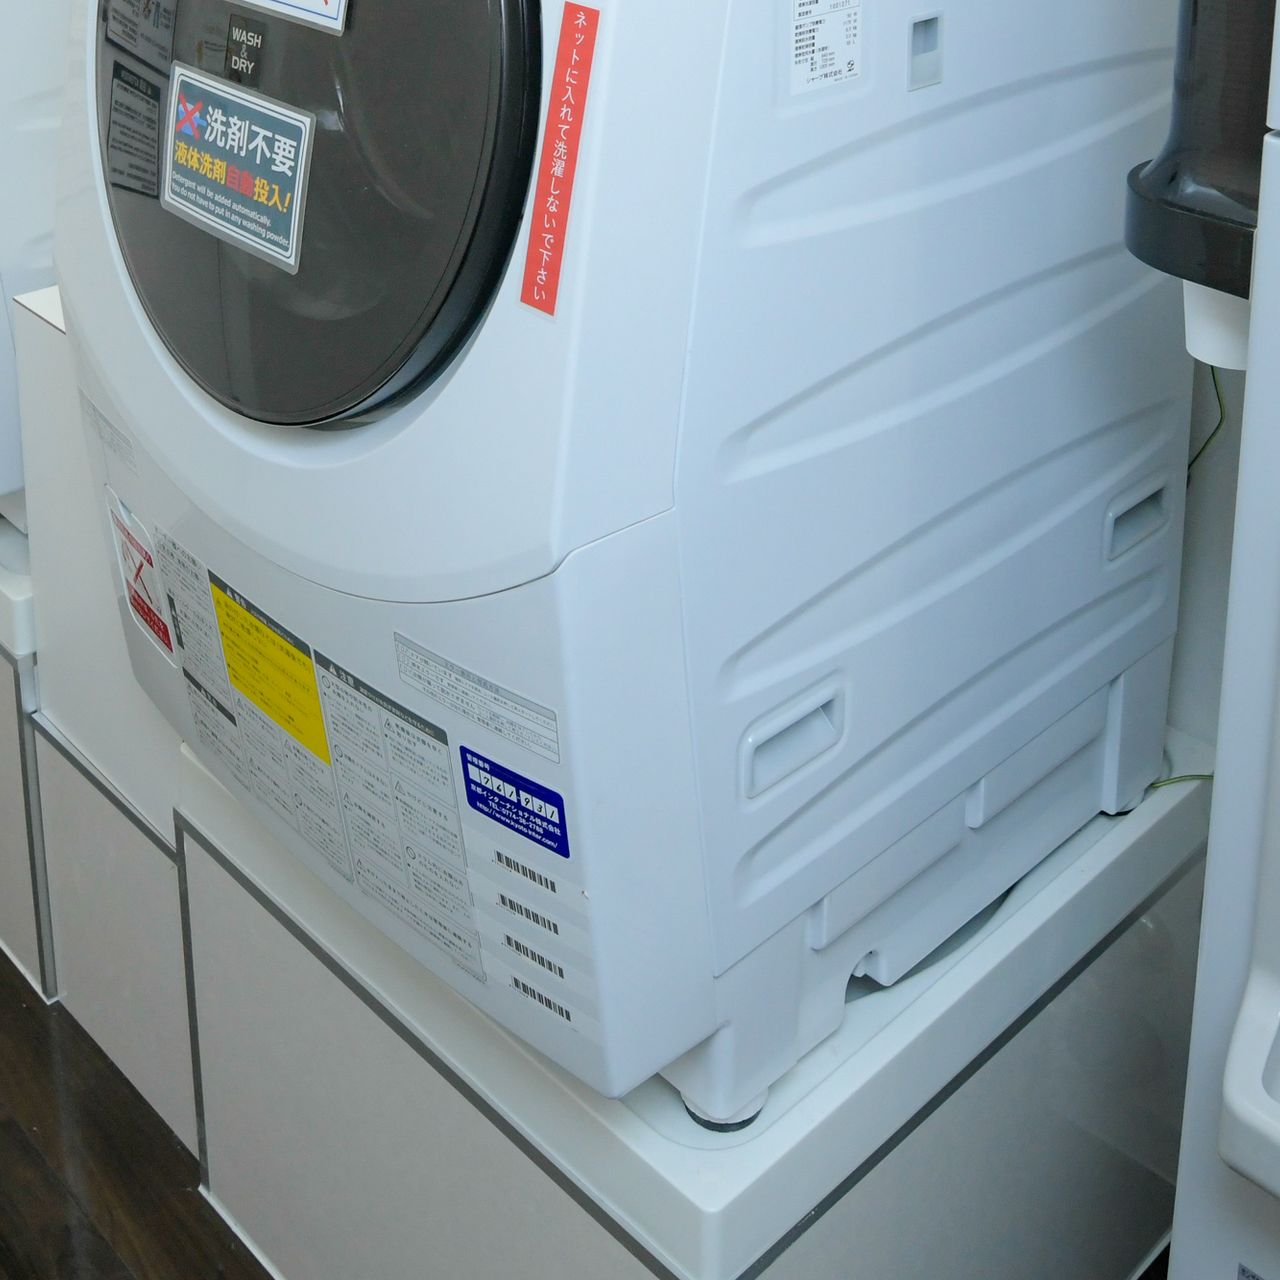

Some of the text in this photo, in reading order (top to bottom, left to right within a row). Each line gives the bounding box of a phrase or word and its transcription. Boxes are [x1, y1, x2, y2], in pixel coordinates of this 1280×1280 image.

[232, 56, 255, 74] DRY
[233, 27, 262, 48] WASH
[240, 45, 248, 58] &
[204, 104, 297, 177] 洗剤不要
[534, 11, 587, 302] ネットに入れて洗濯しないで下さい
[172, 171, 196, 189] Detergent
[197, 185, 206, 195] will
[215, 193, 231, 207] added
[232, 201, 271, 227] automatically.
[174, 140, 292, 213] 液体洗剤自動投入!
